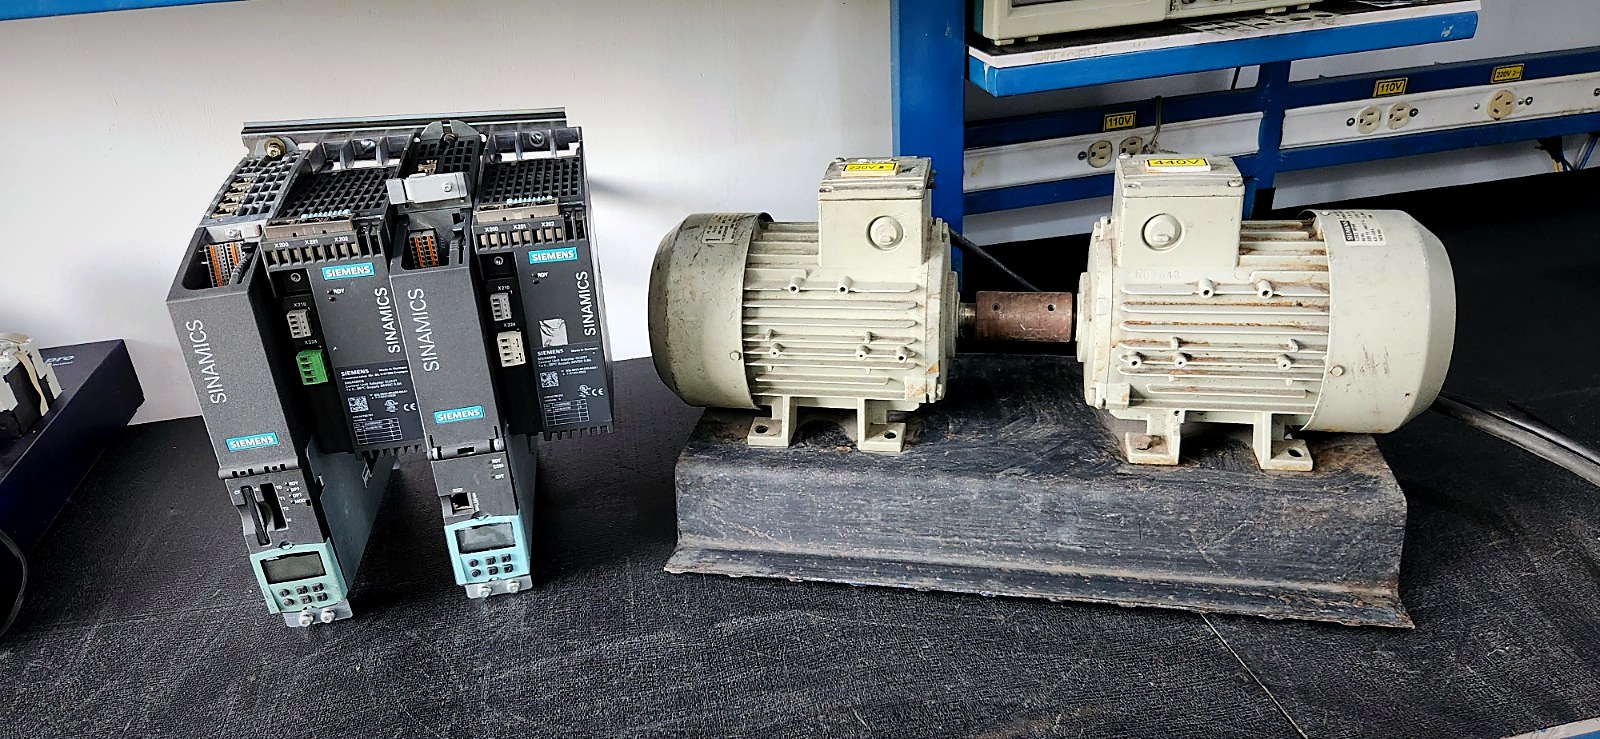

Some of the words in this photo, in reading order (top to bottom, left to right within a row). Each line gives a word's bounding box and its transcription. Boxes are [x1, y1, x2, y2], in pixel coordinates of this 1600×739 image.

[1380, 82, 1403, 93] 110V
[1108, 116, 1132, 128] 110V
[532, 250, 574, 262] SIEMENS
[325, 266, 371, 278] SIEMENS
[576, 271, 596, 336] SINAMICS
[374, 287, 400, 354] SINAMICS
[408, 288, 440, 372] SINAMICS
[186, 320, 227, 404] SINAMICS
[341, 368, 370, 377] SIEMENS
[403, 402, 417, 412] CE
[437, 408, 480, 421] SIEMENS
[230, 435, 274, 448] SIEMENS
